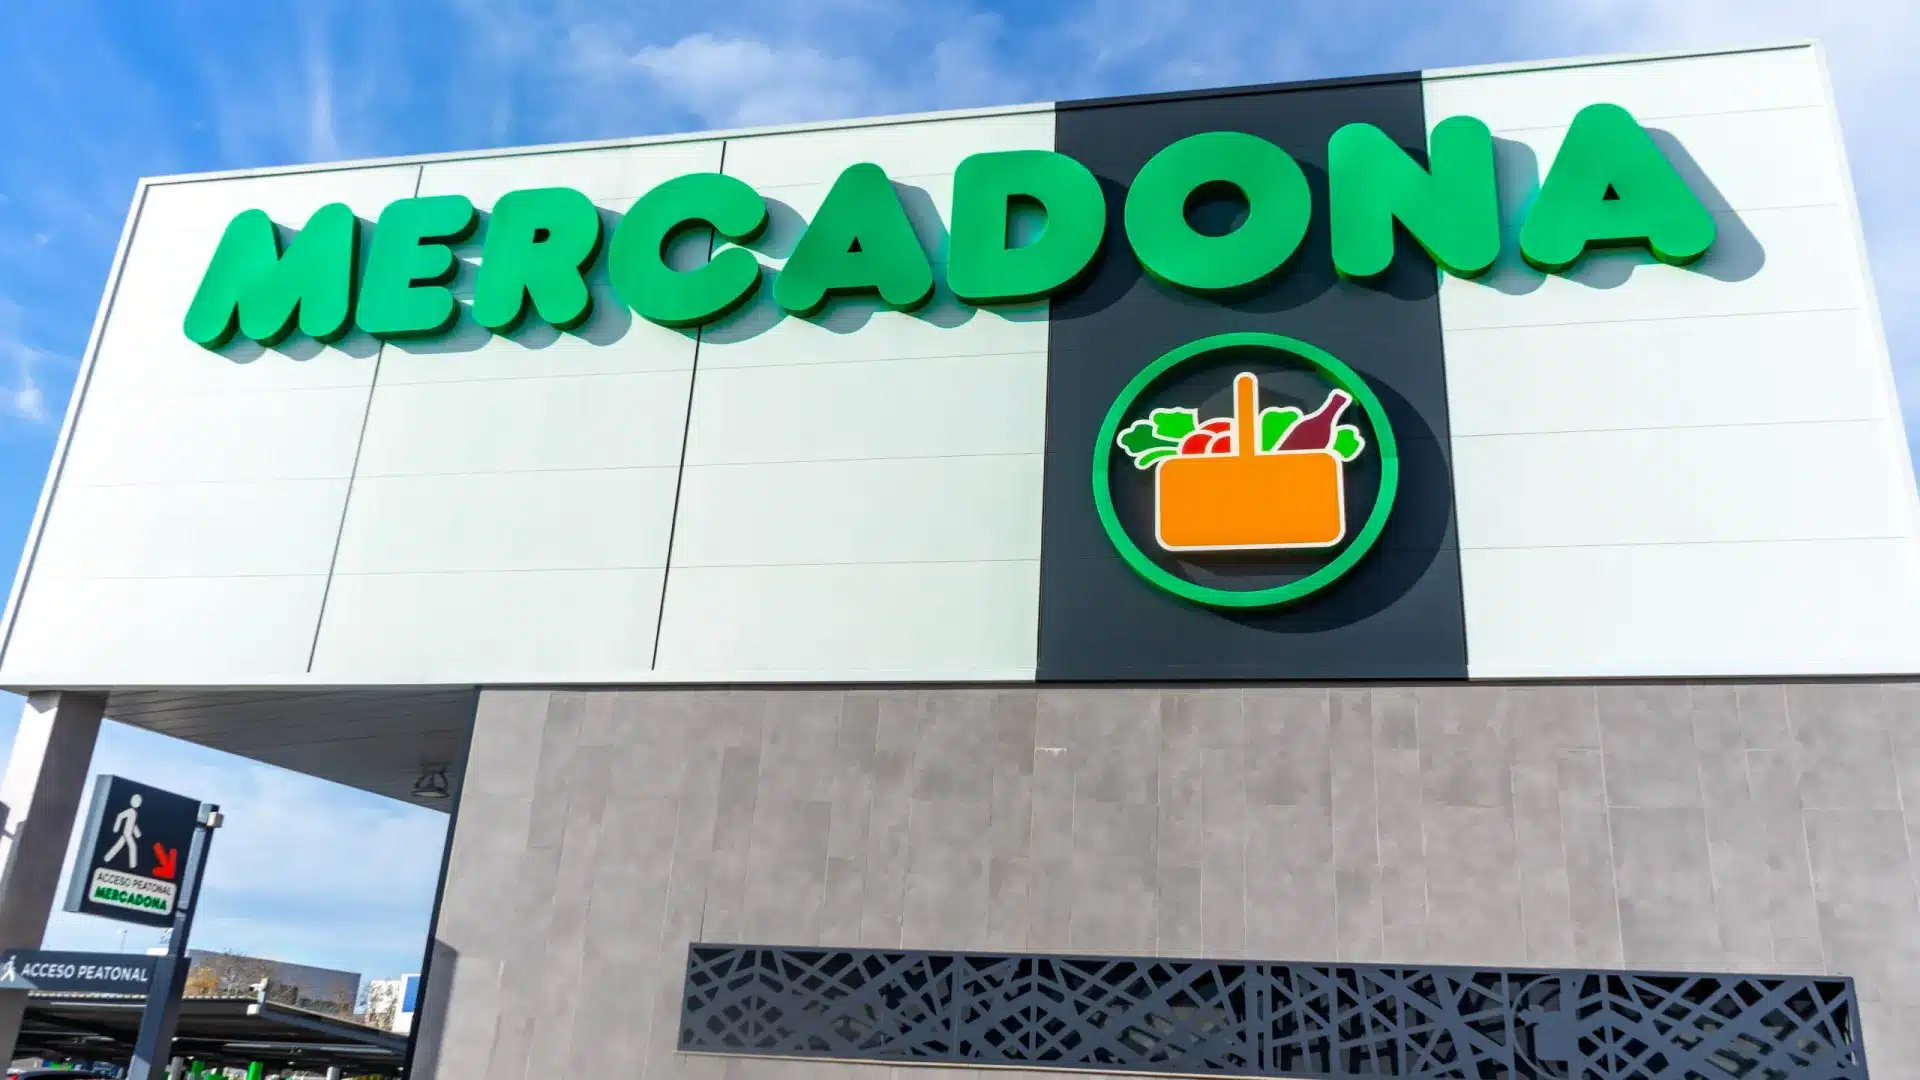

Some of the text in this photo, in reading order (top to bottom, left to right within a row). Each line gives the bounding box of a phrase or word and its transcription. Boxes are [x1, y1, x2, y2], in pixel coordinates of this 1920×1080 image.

[183, 102, 1717, 348] MERCADONA
[97, 872, 172, 896] ACCESO PEATONAL
[94, 886, 168, 911] MERCADONA
[20, 962, 149, 982] ACCESO PEATONAL
